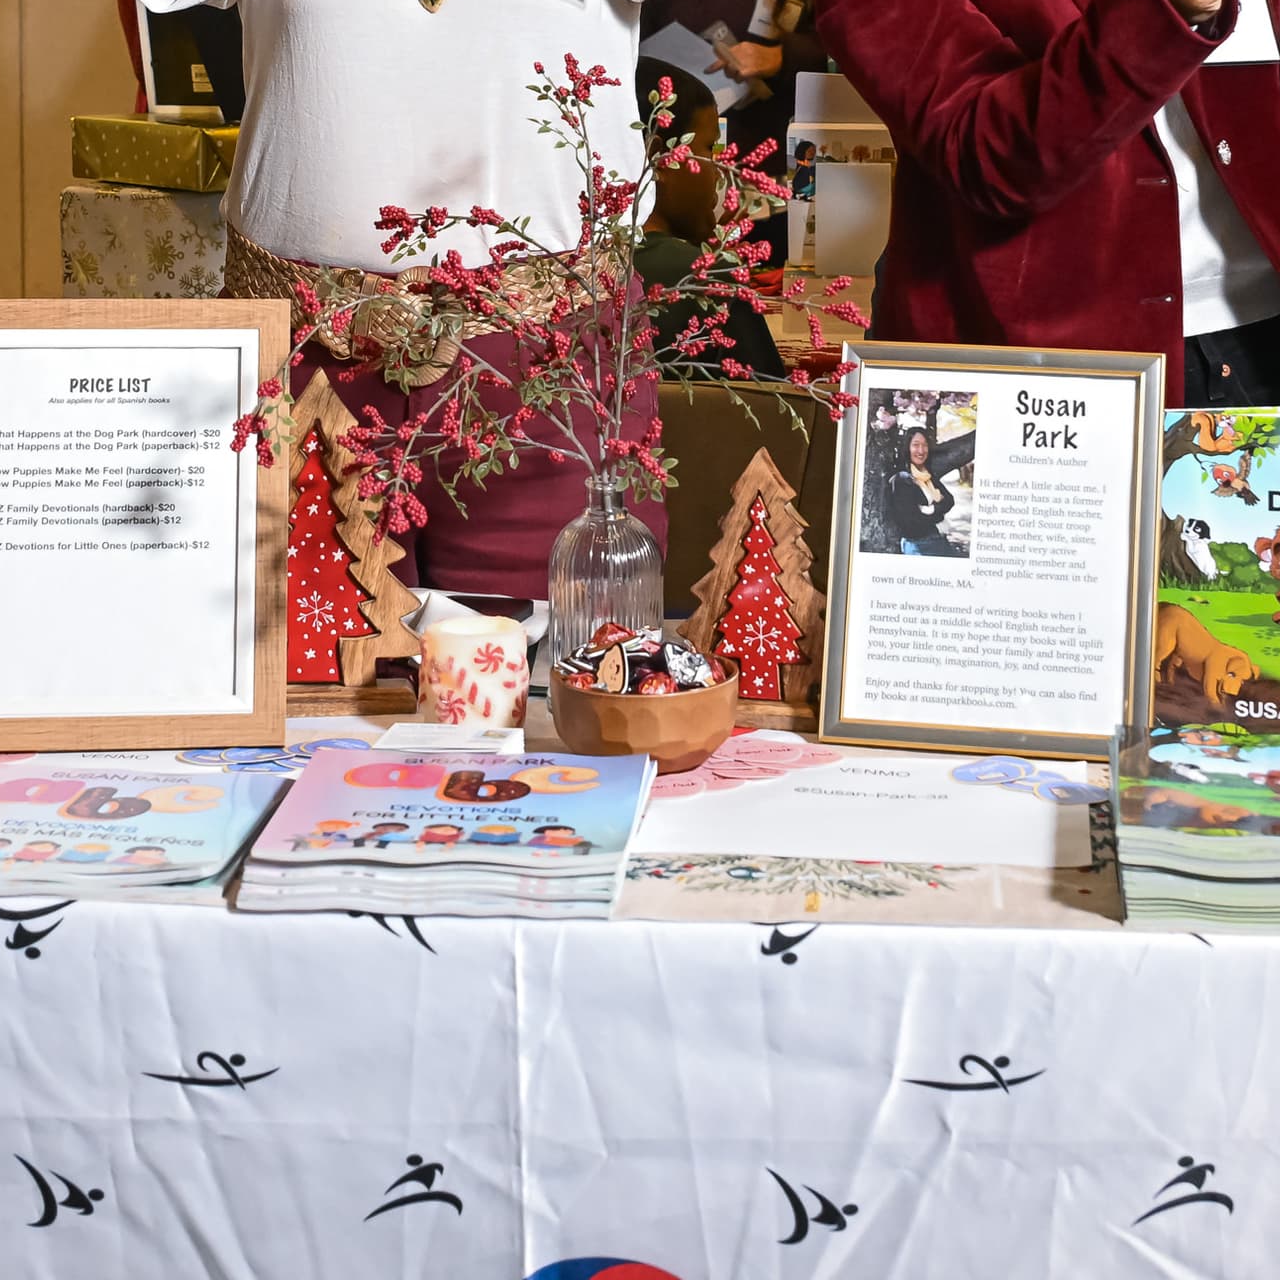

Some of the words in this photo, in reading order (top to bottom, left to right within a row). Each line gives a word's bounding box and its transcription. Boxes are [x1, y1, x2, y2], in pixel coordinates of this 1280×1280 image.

[70, 378, 113, 393] PRICE
[119, 378, 151, 393] LIST
[1016, 390, 1085, 418] Susan
[18, 430, 59, 439] Happens
[64, 430, 73, 438] at
[76, 430, 91, 438] the
[94, 430, 114, 439] Dog
[142, 430, 196, 439] (hardcover)
[200, 429, 220, 437] -$20
[1022, 422, 1077, 449] Park
[17, 443, 59, 451] Happens
[76, 442, 90, 450] the
[94, 442, 113, 451] Dog
[117, 442, 138, 450] Park
[142, 441, 220, 451] (paperback)-$12
[1009, 455, 1054, 465] Children's
[1056, 455, 1088, 467] Author
[13, 467, 52, 476] Puppies
[55, 467, 82, 475] Make
[85, 467, 99, 475] Me
[103, 467, 123, 475] Feel
[126, 466, 184, 476] (hardcover)-
[188, 466, 205, 474] $20
[13, 480, 51, 489] Puppies
[103, 479, 122, 487] Feel
[126, 478, 204, 489] (paperback)-$12
[7, 504, 38, 514] Family
[42, 504, 99, 512] Devotionals
[103, 503, 175, 514] (hardback)-$20
[6, 517, 38, 526] Family
[41, 517, 99, 525] Devotionals
[102, 516, 181, 526] (paperback)-$12
[5, 542, 54, 550] Devotions
[58, 542, 71, 550] for
[74, 542, 99, 550] Little
[102, 542, 127, 550] Ones
[130, 541, 209, 551] (paperback)-$12
[872, 576, 894, 584] town
[897, 576, 906, 584] of
[909, 577, 954, 588] Brookline,
[956, 580, 975, 589] MA.
[405, 758, 487, 766] SUSAN
[488, 758, 556, 766] PARK
[51, 771, 128, 782] SUSAN
[132, 775, 193, 784] PARK
[839, 767, 911, 778] VENMO
[389, 804, 522, 814] DEVOTIONS
[352, 811, 397, 819] FOR
[403, 812, 489, 821] LITTLE
[498, 815, 560, 824] ONES
[4, 819, 139, 833] DEVOCIONES
